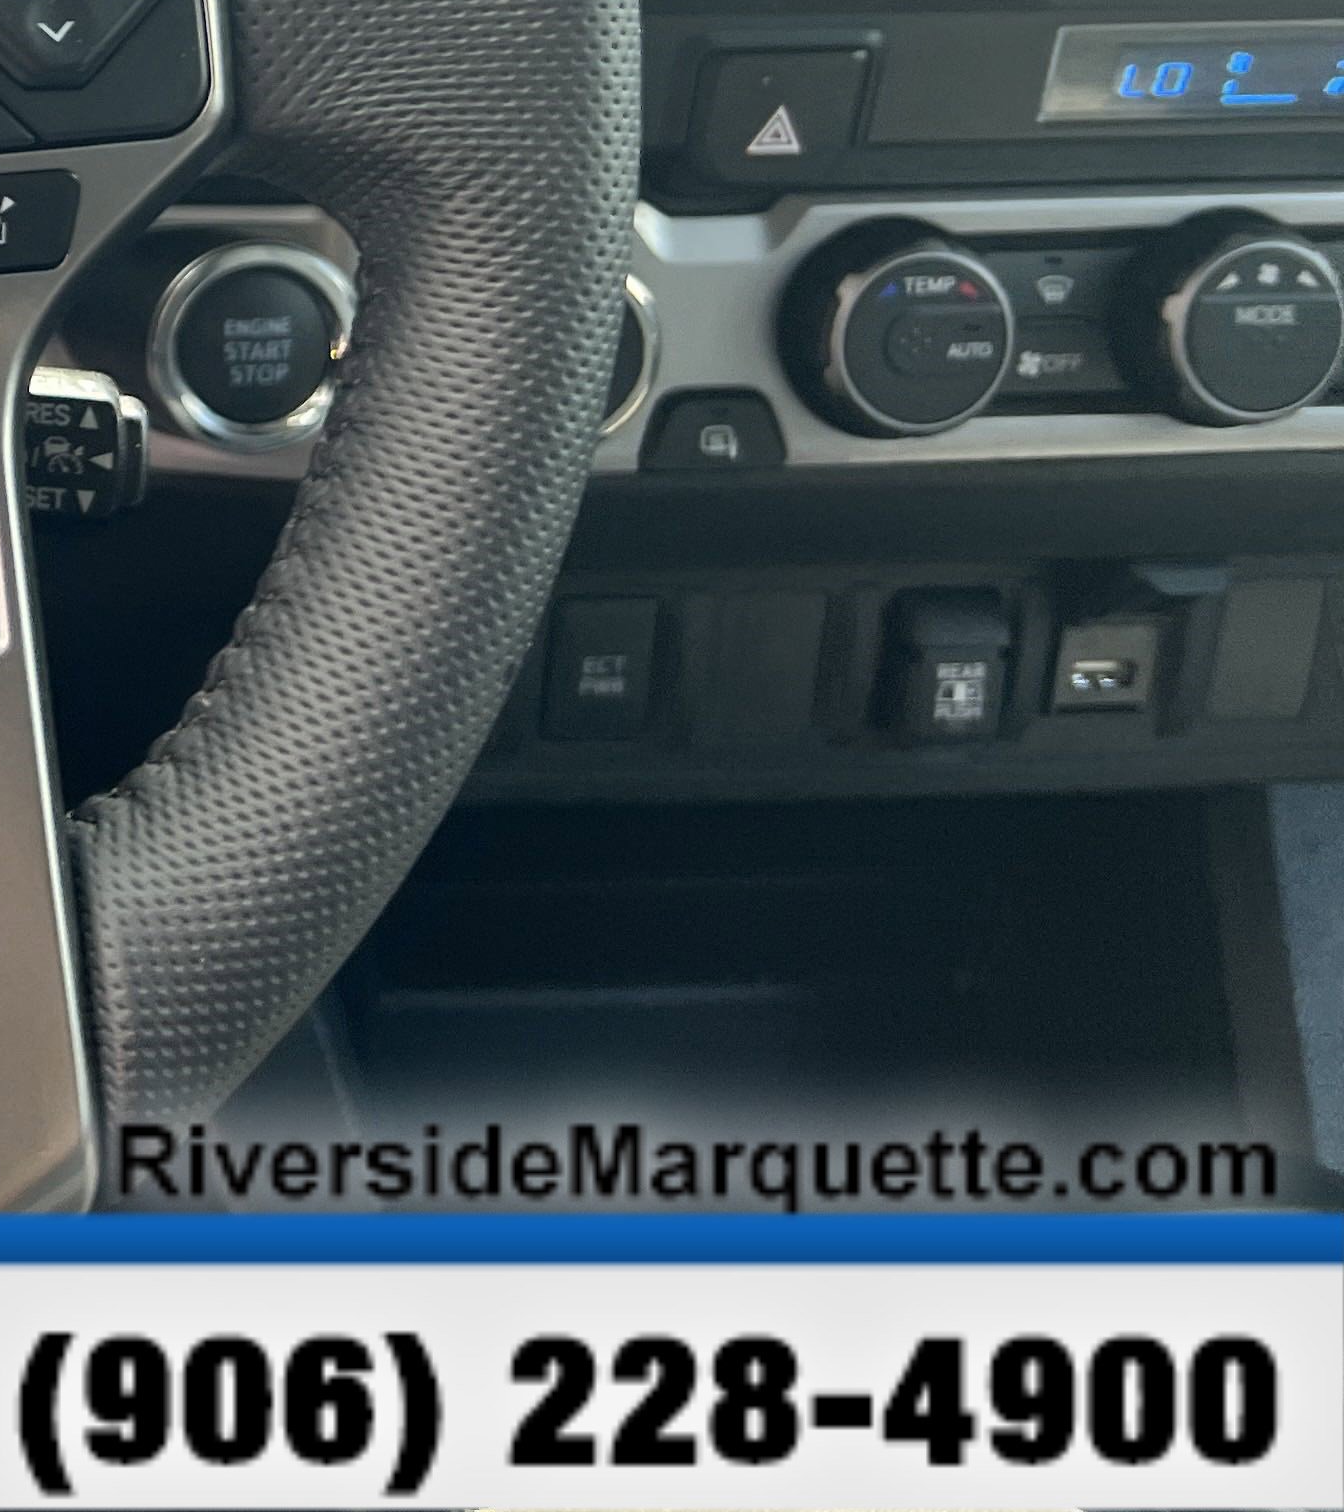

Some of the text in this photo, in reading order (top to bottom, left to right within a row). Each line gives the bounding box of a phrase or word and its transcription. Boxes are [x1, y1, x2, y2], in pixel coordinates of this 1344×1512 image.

[903, 275, 957, 297] TEMP
[1233, 303, 1296, 325] MODE
[223, 317, 292, 337] ENGINE
[223, 340, 292, 361] START
[946, 340, 995, 362] AUTO
[229, 363, 291, 385] STOP
[1042, 353, 1084, 374] OFF
[25, 402, 72, 426] RES
